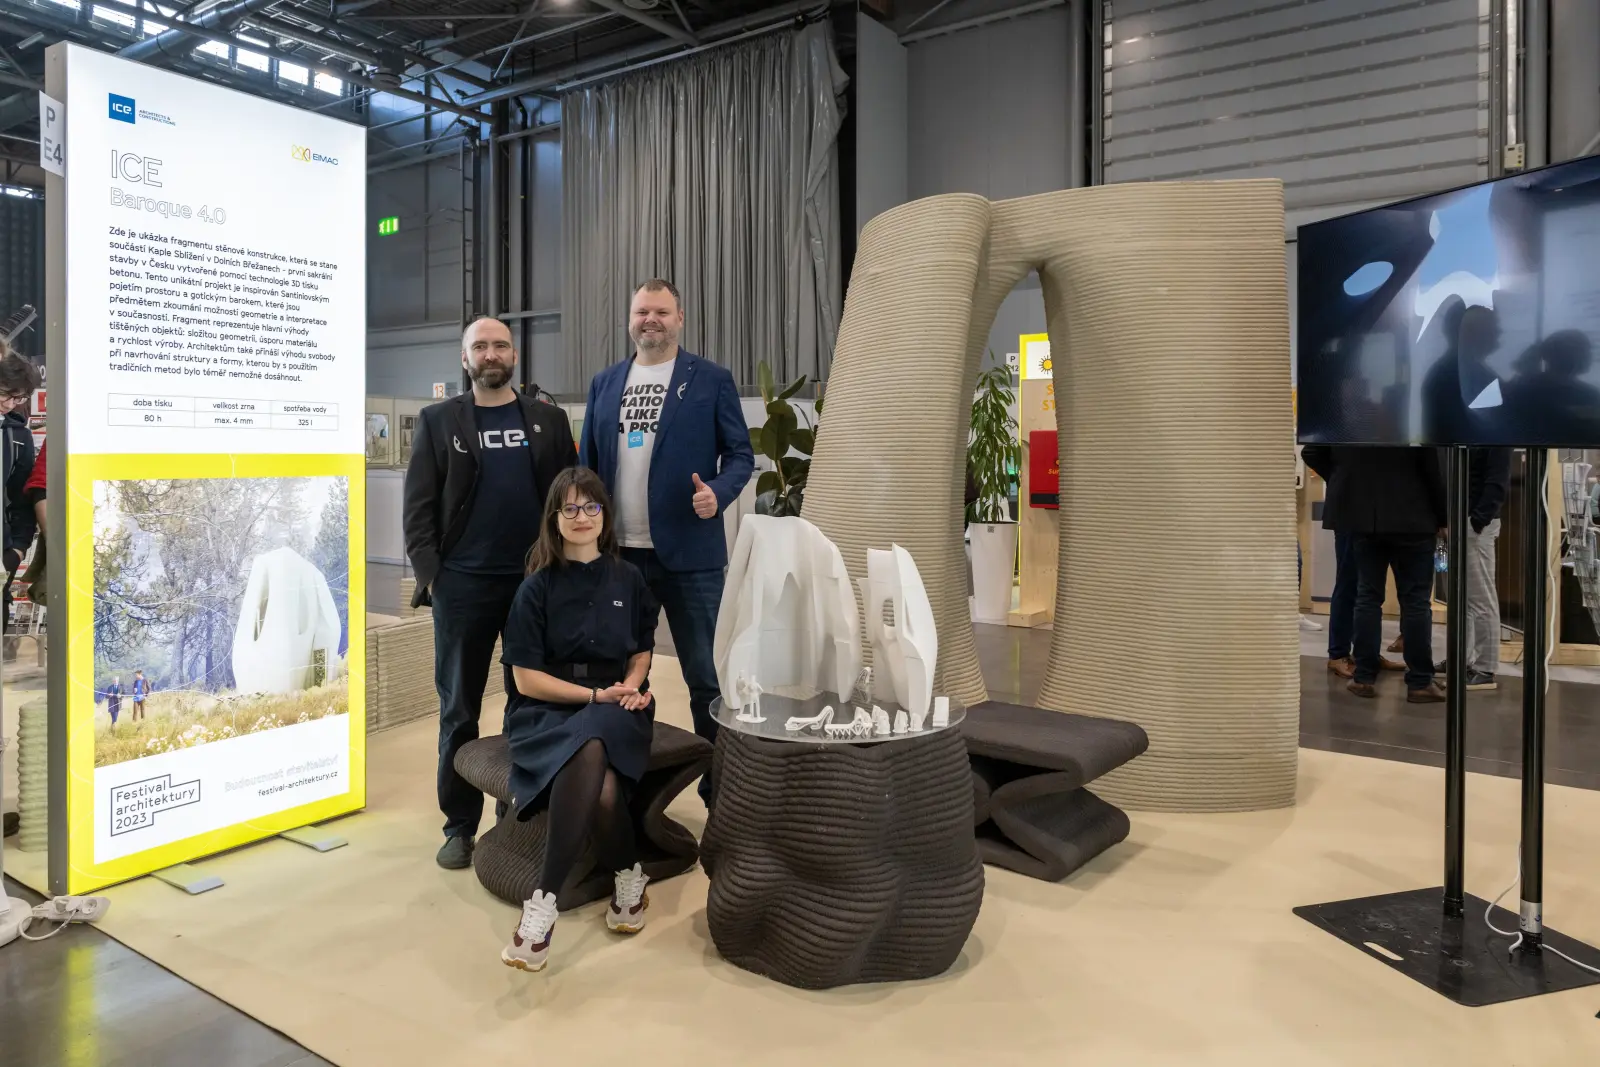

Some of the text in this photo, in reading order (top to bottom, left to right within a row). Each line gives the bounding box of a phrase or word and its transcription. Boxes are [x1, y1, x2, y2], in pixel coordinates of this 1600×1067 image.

[46, 106, 56, 128] P
[139, 113, 176, 126] CONSTRUCTIONS
[44, 136, 63, 166] E4
[111, 150, 162, 187] ICE
[111, 187, 226, 225] Baroque 4.0
[109, 226, 126, 237] Zde
[128, 229, 137, 239] je
[138, 232, 169, 244] ukázka
[170, 236, 213, 250] fragmentu
[215, 244, 245, 256] stěnové
[289, 255, 308, 265] která
[319, 262, 338, 270] stane
[109, 241, 146, 253] součástí
[148, 245, 172, 257] Kaple
[213, 256, 241, 267] Dolních
[242, 260, 281, 273] Břežanech
[109, 254, 139, 266] stavby
[149, 257, 175, 270] Česku
[176, 264, 218, 276] vytvořené
[249, 274, 290, 287] technologie
[291, 279, 301, 288] 3D
[110, 266, 330, 303] betonu. Tento unikátní projekt je inspirován Santiniovským
[110, 282, 143, 292] pojetím
[145, 286, 181, 297] prostoru
[190, 292, 227, 303] gotickým
[265, 300, 285, 309] které
[285, 302, 300, 311] jsou
[110, 294, 161, 308] předmětem
[240, 310, 278, 321] geometrie
[286, 314, 328, 326] interpretace
[109, 321, 150, 333] tištěných
[151, 326, 185, 336] objektů:
[187, 329, 218, 339] složitou
[259, 335, 284, 345] úsporu
[285, 339, 318, 348] materiálu
[117, 310, 170, 322] současnosti.
[172, 314, 211, 326] Fragment
[212, 320, 260, 332] reprezentuje
[283, 326, 310, 336] výhody
[110, 348, 122, 358] při
[124, 350, 171, 360] navrhování
[172, 354, 211, 365] struktury
[219, 356, 244, 367] formy,
[245, 358, 270, 368] kterou
[272, 360, 281, 370] by
[118, 336, 153, 346] rychlost
[154, 339, 185, 350] výroby.
[186, 341, 235, 353] Architektům
[236, 346, 254, 354] také
[281, 350, 307, 359] výhodu
[308, 353, 336, 362] svobody
[109, 362, 303, 382] tradičních metod bylo téměř nemožné dosáhnout.
[435, 385, 444, 398] 13
[621, 396, 663, 407] ATIO
[623, 384, 668, 396] AUTO-
[284, 405, 310, 413] spotřeba
[625, 408, 658, 420] LIKE
[630, 421, 659, 433] PRO
[116, 780, 166, 802] Festival
[258, 771, 338, 796] festival-architektury.cz
[116, 789, 194, 815] architektury
[116, 813, 146, 829] 2023
